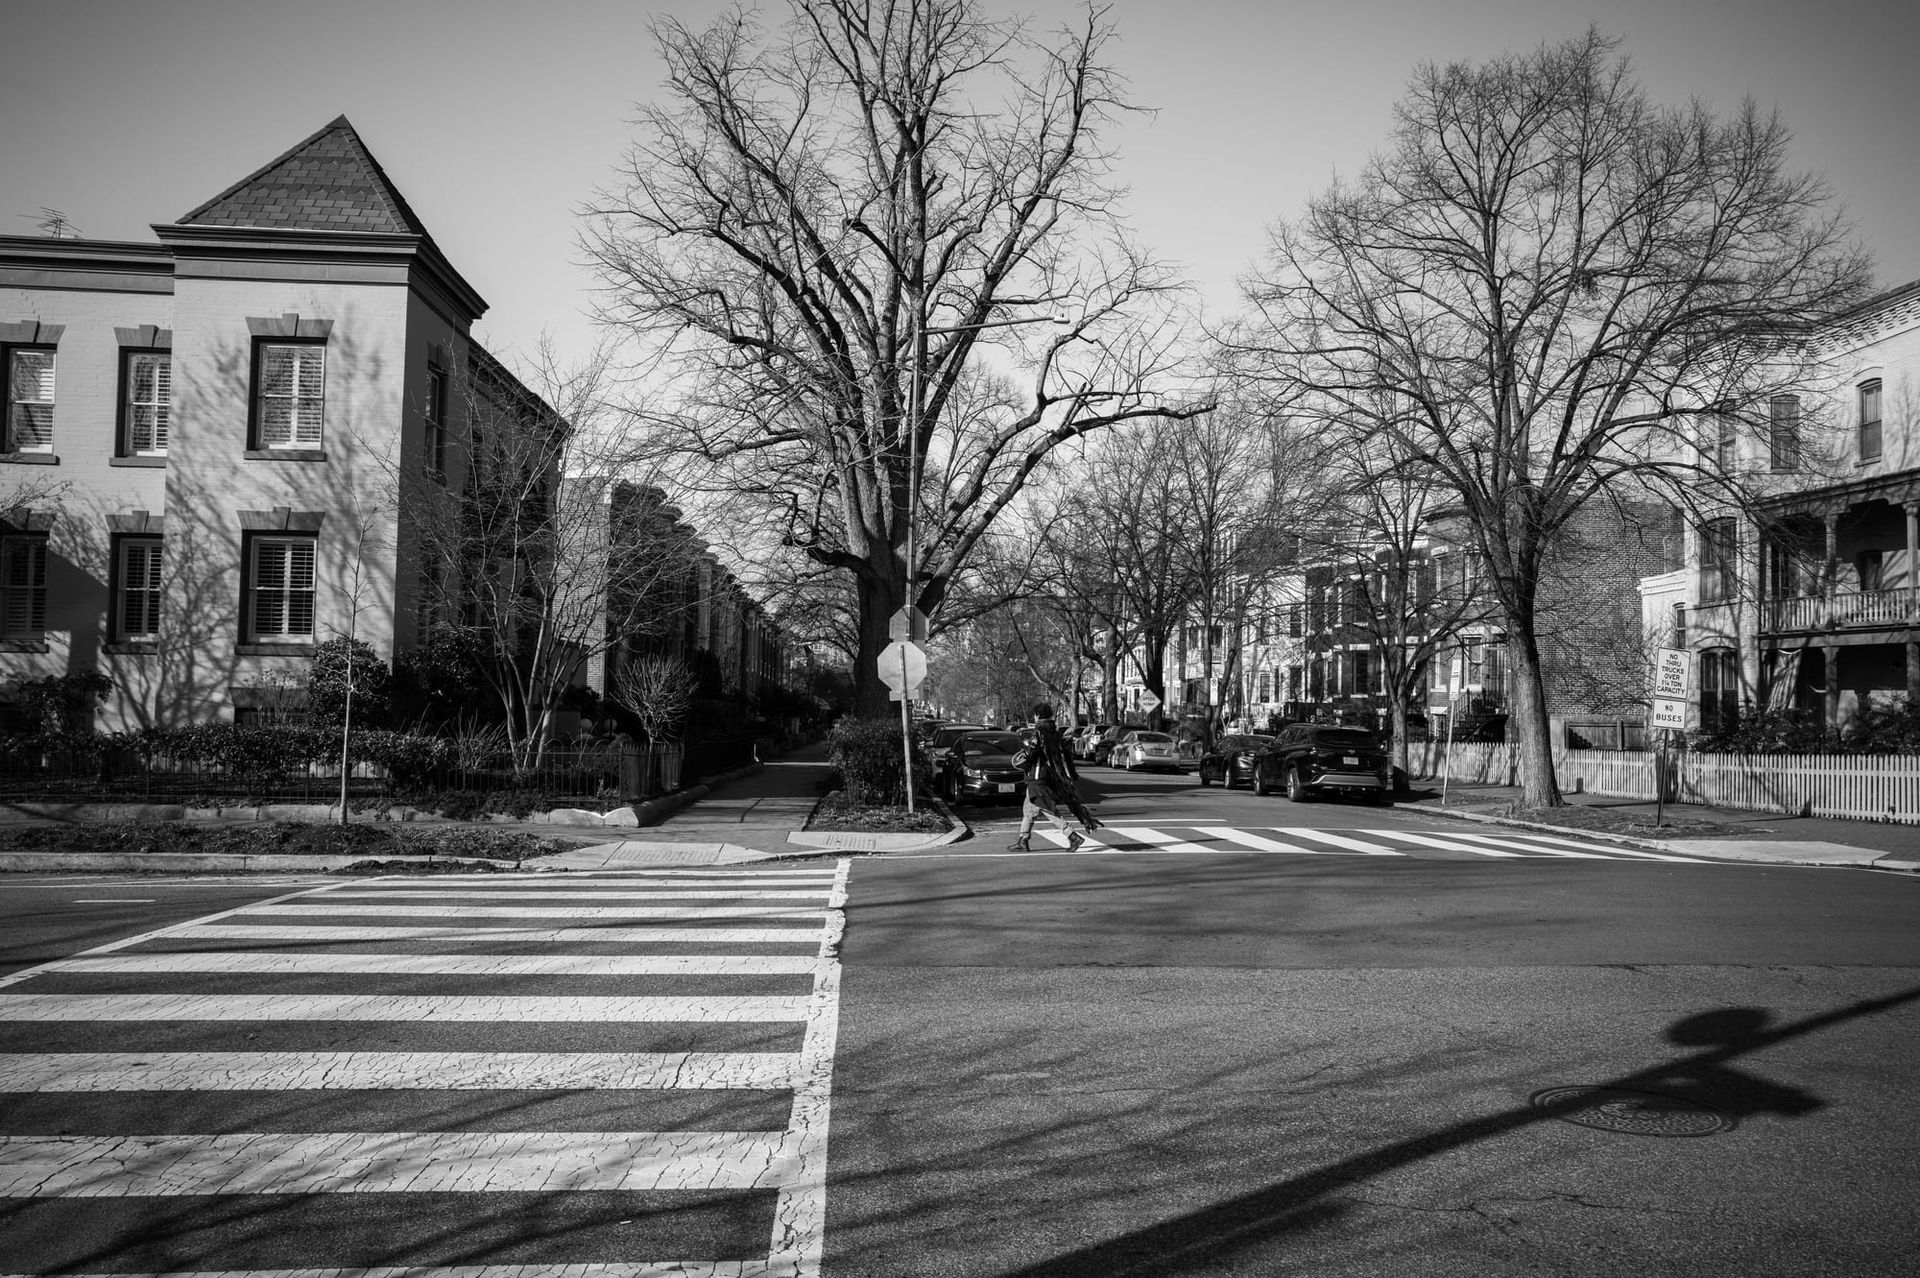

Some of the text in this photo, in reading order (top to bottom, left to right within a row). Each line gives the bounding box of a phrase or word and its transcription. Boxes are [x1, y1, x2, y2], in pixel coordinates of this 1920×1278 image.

[1666, 659, 1682, 667] THRU
[1661, 665, 1685, 674] TRUCKS
[1664, 673, 1681, 681] OVER
[1656, 686, 1686, 695] CAPACITY
[1664, 704, 1674, 712] NO
[1656, 713, 1682, 722] BUSES
